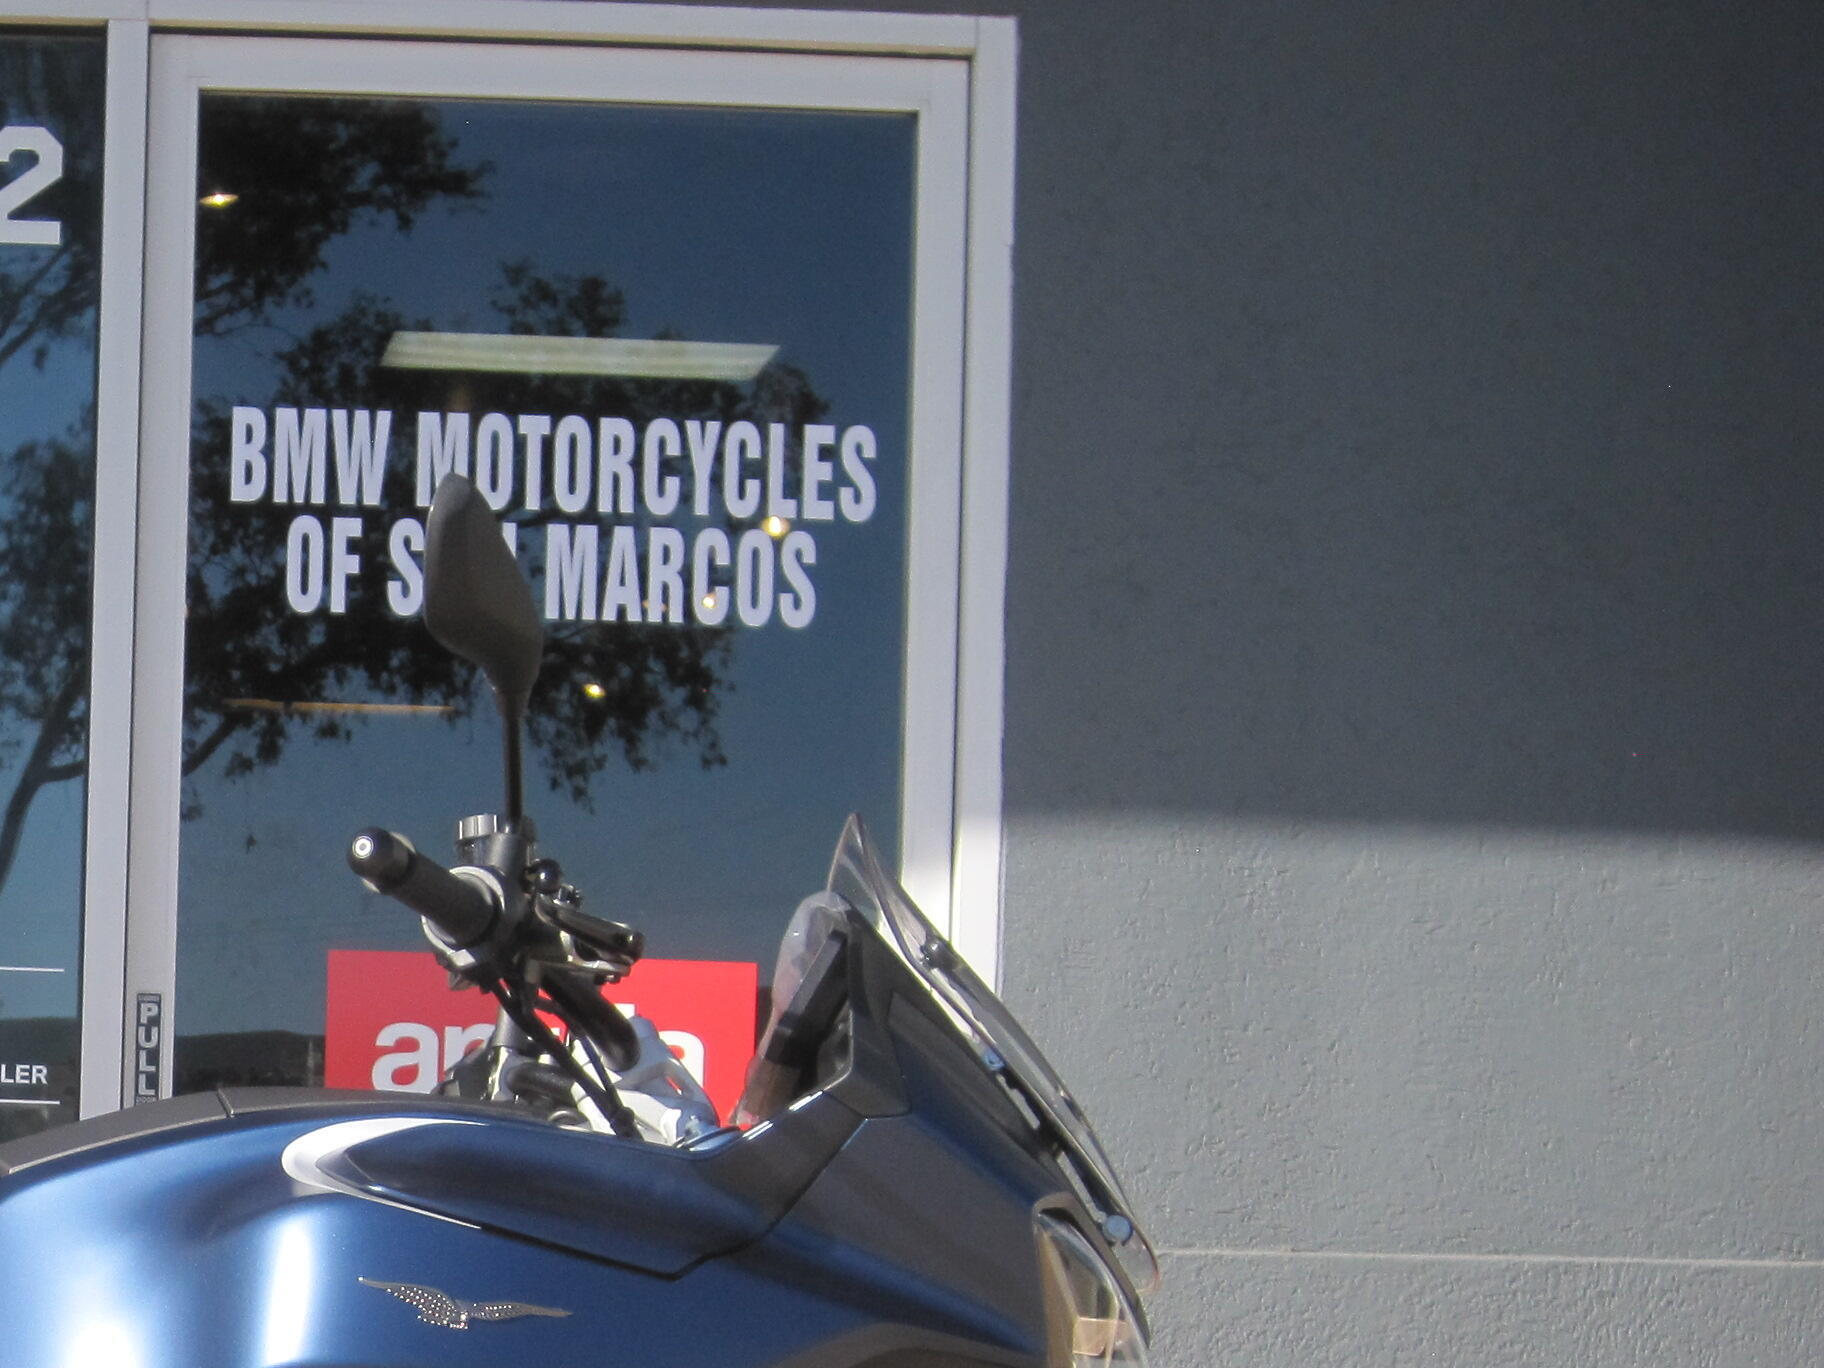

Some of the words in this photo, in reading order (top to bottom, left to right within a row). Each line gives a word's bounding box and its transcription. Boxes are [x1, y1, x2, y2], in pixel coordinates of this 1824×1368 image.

[230, 405, 392, 505] BMW
[416, 411, 878, 523] MOTORCYCLES
[286, 514, 362, 615] OF
[544, 523, 818, 629] MARCOS
[137, 1002, 159, 1096] PULL
